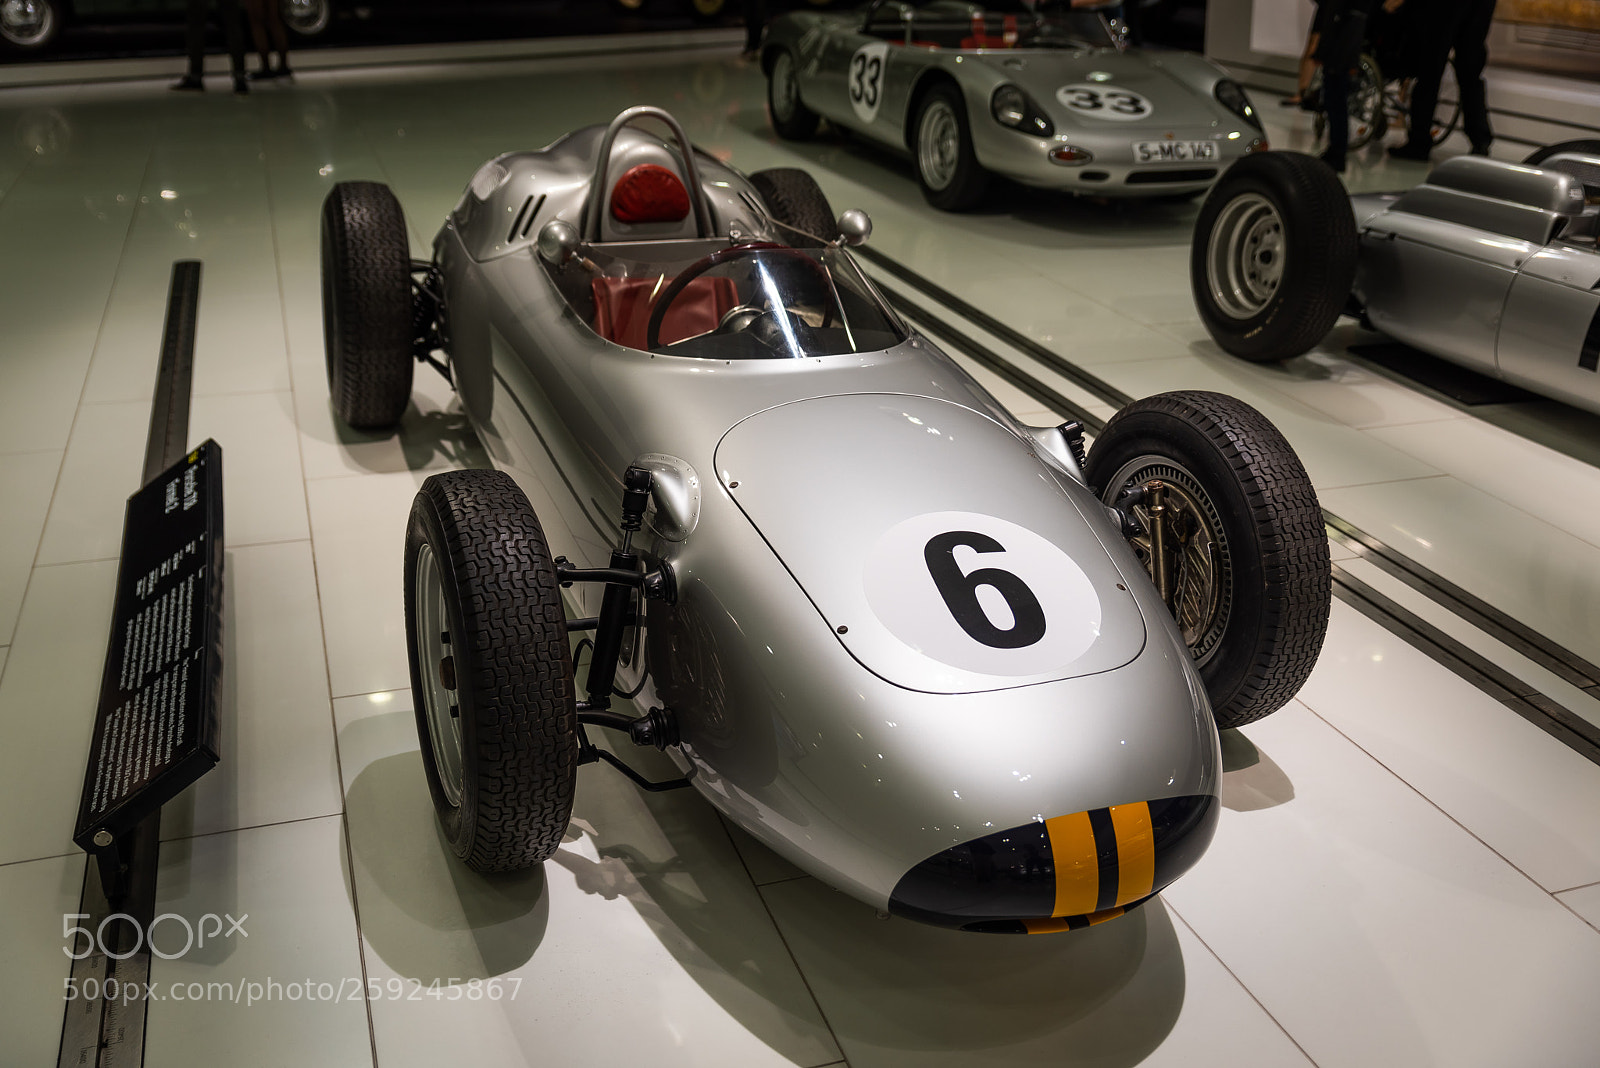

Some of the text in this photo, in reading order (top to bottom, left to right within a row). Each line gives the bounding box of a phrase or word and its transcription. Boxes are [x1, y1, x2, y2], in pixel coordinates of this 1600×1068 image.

[850, 52, 881, 108] 33
[1064, 88, 1146, 116] 33
[1139, 142, 1187, 161] S-MC
[923, 530, 1047, 650] 6
